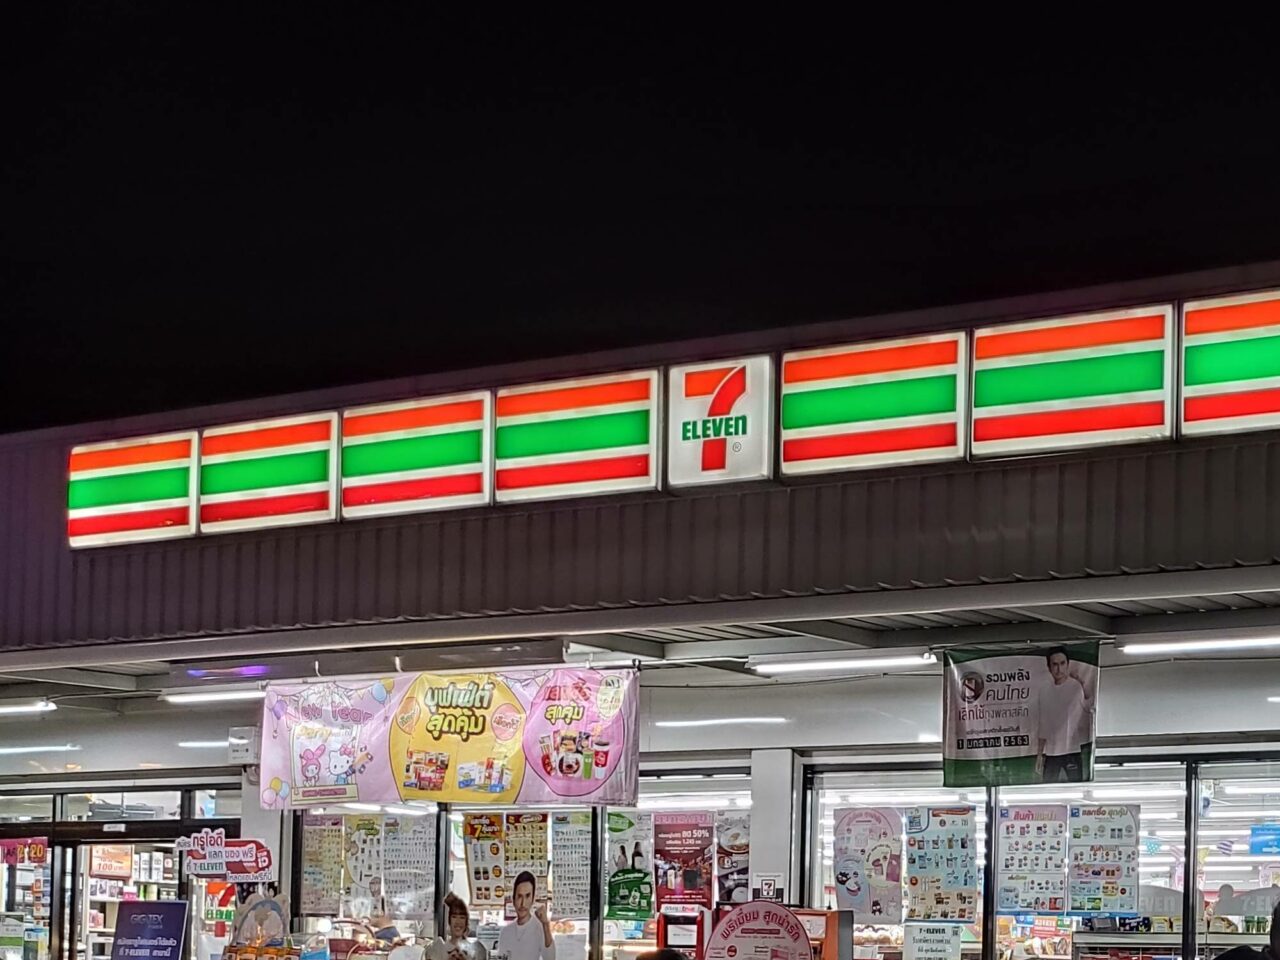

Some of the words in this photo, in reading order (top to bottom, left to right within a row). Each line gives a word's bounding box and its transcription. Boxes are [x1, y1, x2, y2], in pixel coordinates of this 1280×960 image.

[684, 366, 747, 472] 7
[985, 669, 1031, 683] รวมพลัง
[985, 684, 1030, 701] คนไทย
[426, 708, 487, 742] สุดคุ้ม
[1004, 735, 1029, 746] 2563
[720, 908, 760, 941] พรีเมียม
